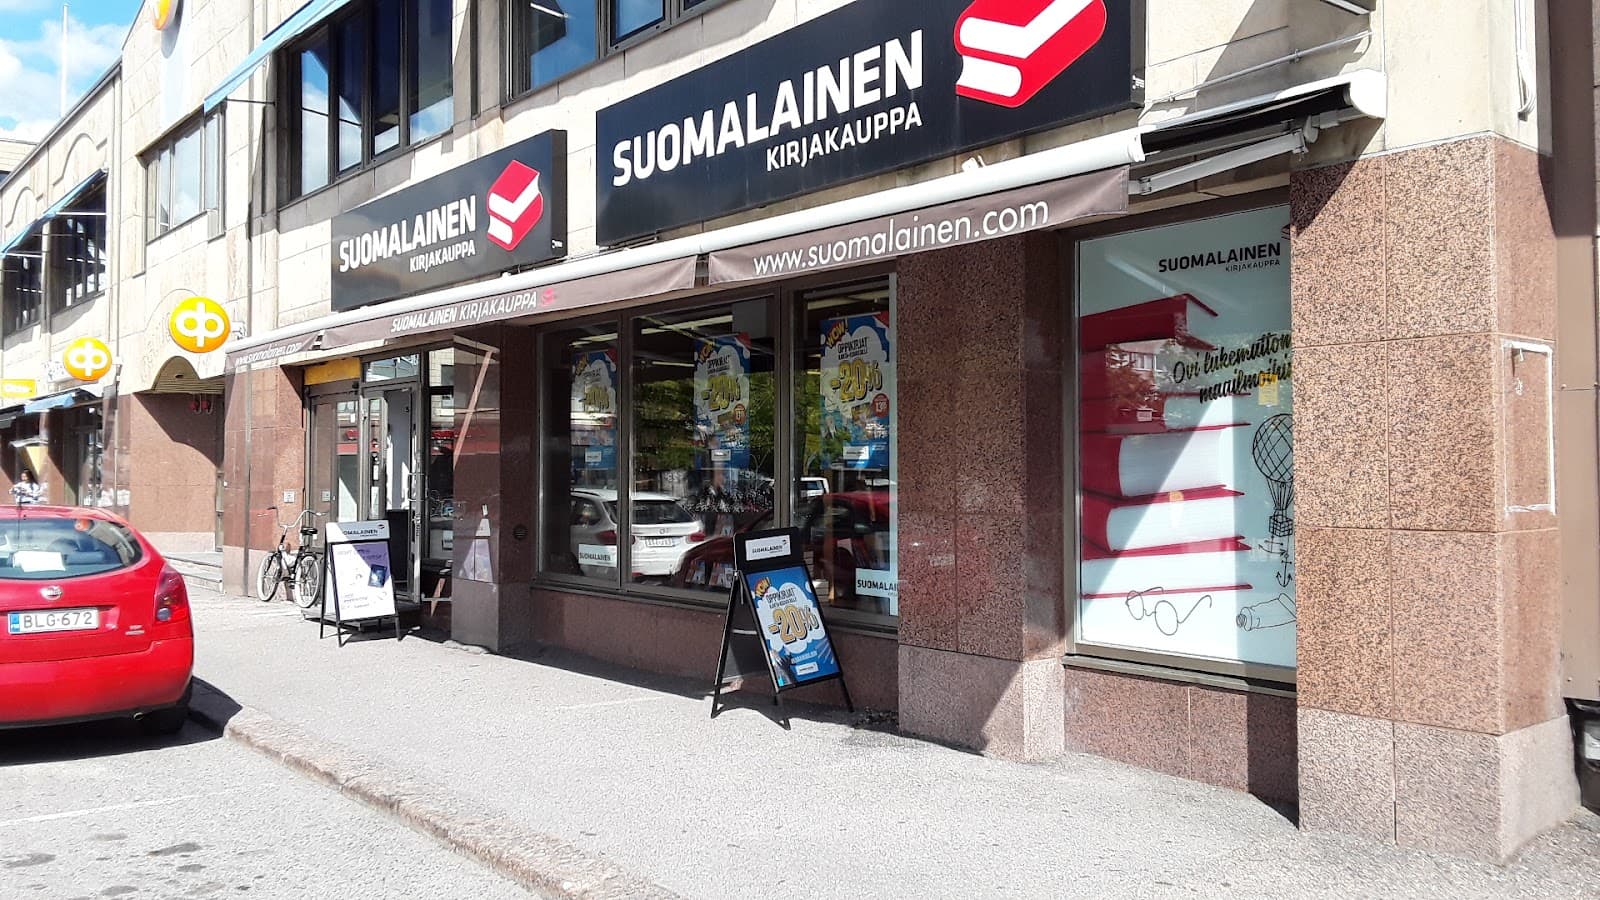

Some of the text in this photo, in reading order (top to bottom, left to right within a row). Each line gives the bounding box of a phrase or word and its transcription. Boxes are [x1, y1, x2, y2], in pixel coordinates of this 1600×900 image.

[613, 29, 923, 187] SUOMALAINEN
[766, 102, 922, 171] KIRJAKAUPPA
[339, 195, 476, 273] SUOMALAINEN
[753, 200, 1049, 275] www.suomalainen.com
[410, 240, 476, 272] KIRJAKAUPPA
[1158, 242, 1281, 273] SUOMALAINEN
[1225, 259, 1280, 272] KIRJAKAUPPA
[390, 291, 537, 333] SUOMALAINEN KIRJAKAUPPA
[831, 358, 882, 402] -20%
[1174, 352, 1200, 383] Ovi
[23, 612, 93, 629] BLG-672
[768, 604, 820, 645] -20%
